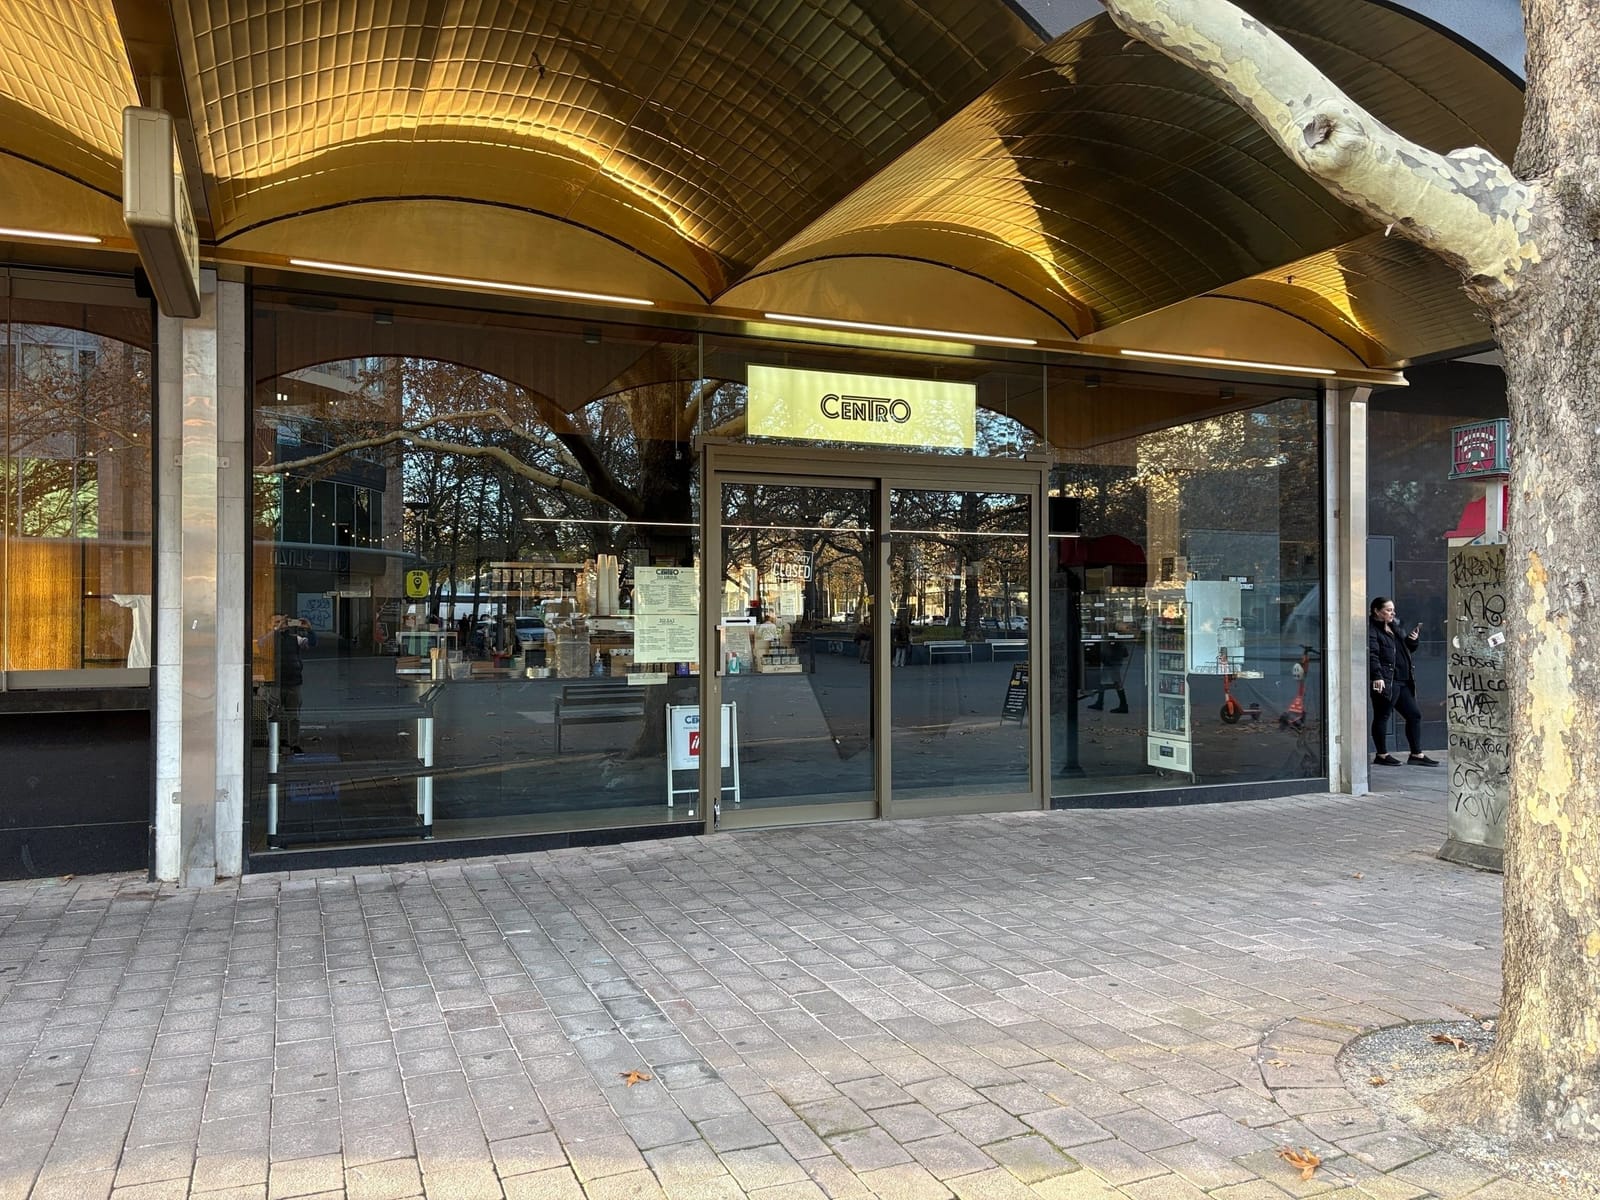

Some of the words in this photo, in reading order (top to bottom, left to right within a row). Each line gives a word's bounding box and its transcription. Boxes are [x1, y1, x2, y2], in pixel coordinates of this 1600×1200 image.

[820, 393, 912, 424] CENTRO
[773, 562, 811, 579] CLOSED
[1448, 671, 1508, 692] WELLCO
